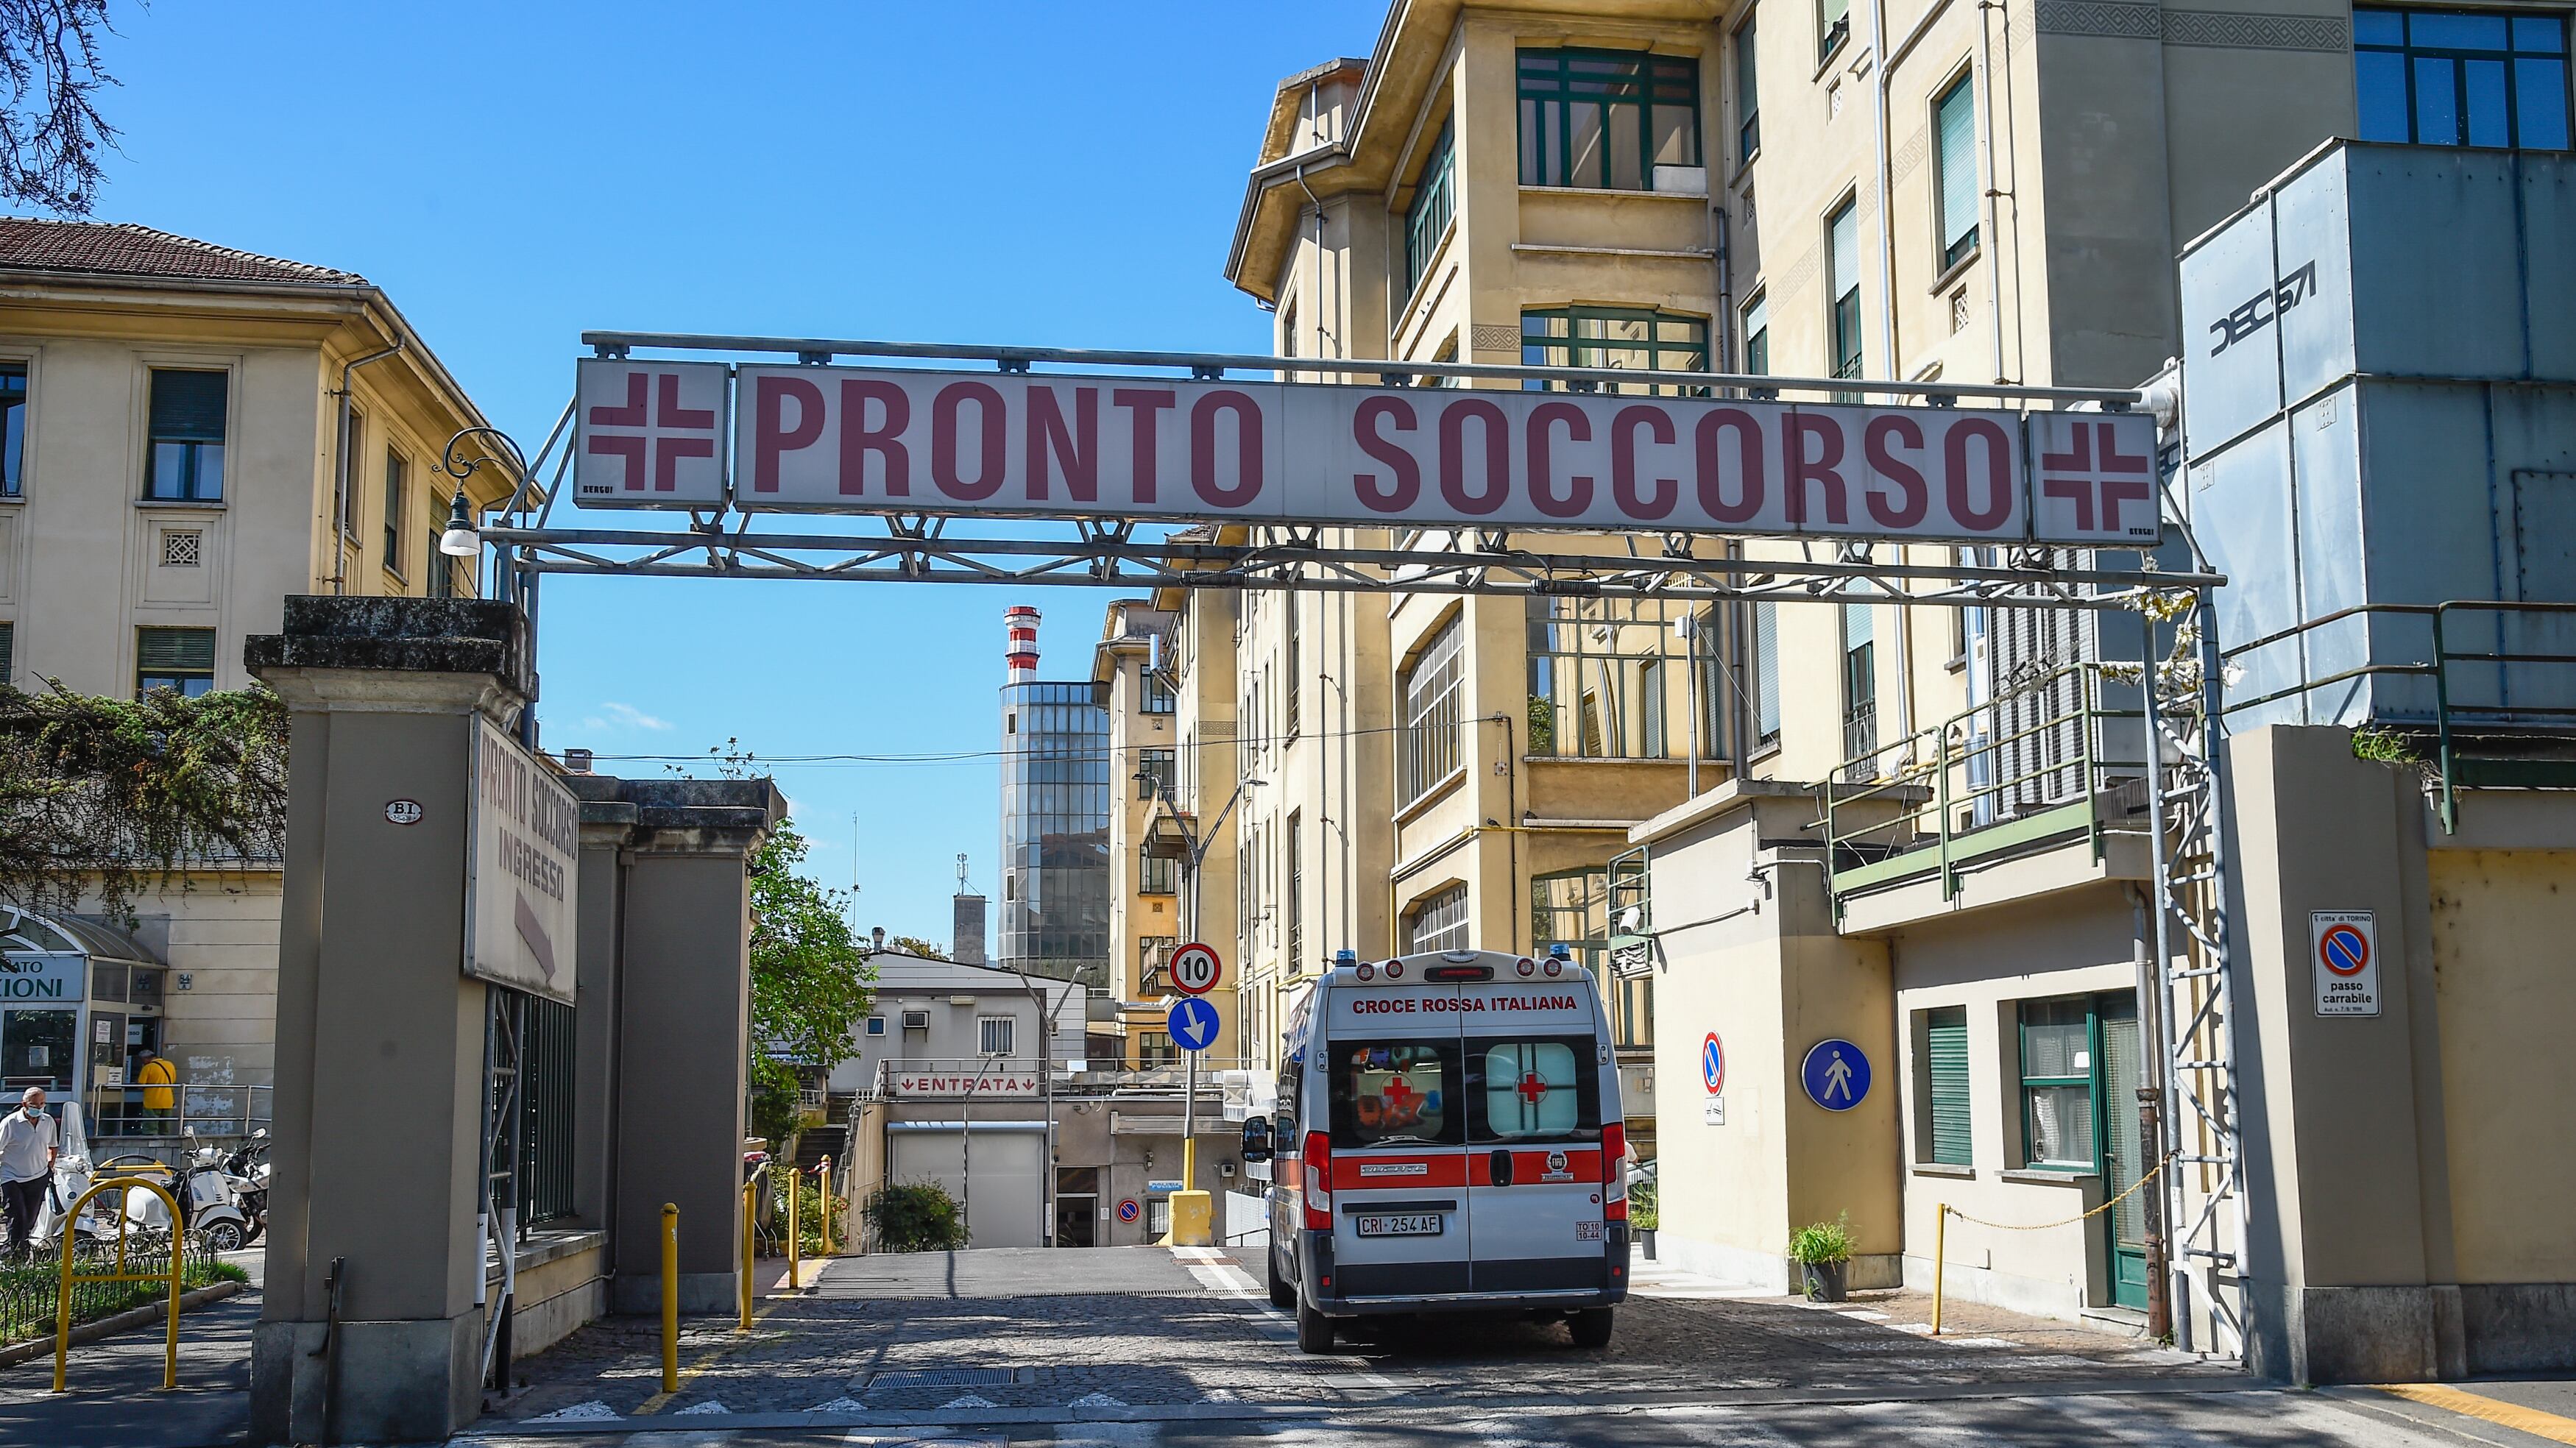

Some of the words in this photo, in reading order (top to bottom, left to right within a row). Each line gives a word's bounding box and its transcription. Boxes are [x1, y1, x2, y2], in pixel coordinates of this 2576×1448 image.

[754, 376, 1263, 508] PRONTO
[1354, 395, 2013, 530] SOCCORSO
[481, 731, 526, 825] PRONTO
[532, 773, 577, 861] SOCCORSO
[499, 826, 564, 902] INGRESSO
[1183, 957, 1209, 981] 10
[0, 978, 62, 998] IONI
[2331, 983, 2363, 993] passo
[1353, 999, 1416, 1014] CROCE
[1422, 998, 1485, 1012] ROSSA
[1491, 995, 1577, 1011] ITALIANA
[2323, 993, 2372, 1004] carrabile
[918, 1078, 1019, 1091] ENTRATA
[1362, 1218, 1382, 1233] CRI
